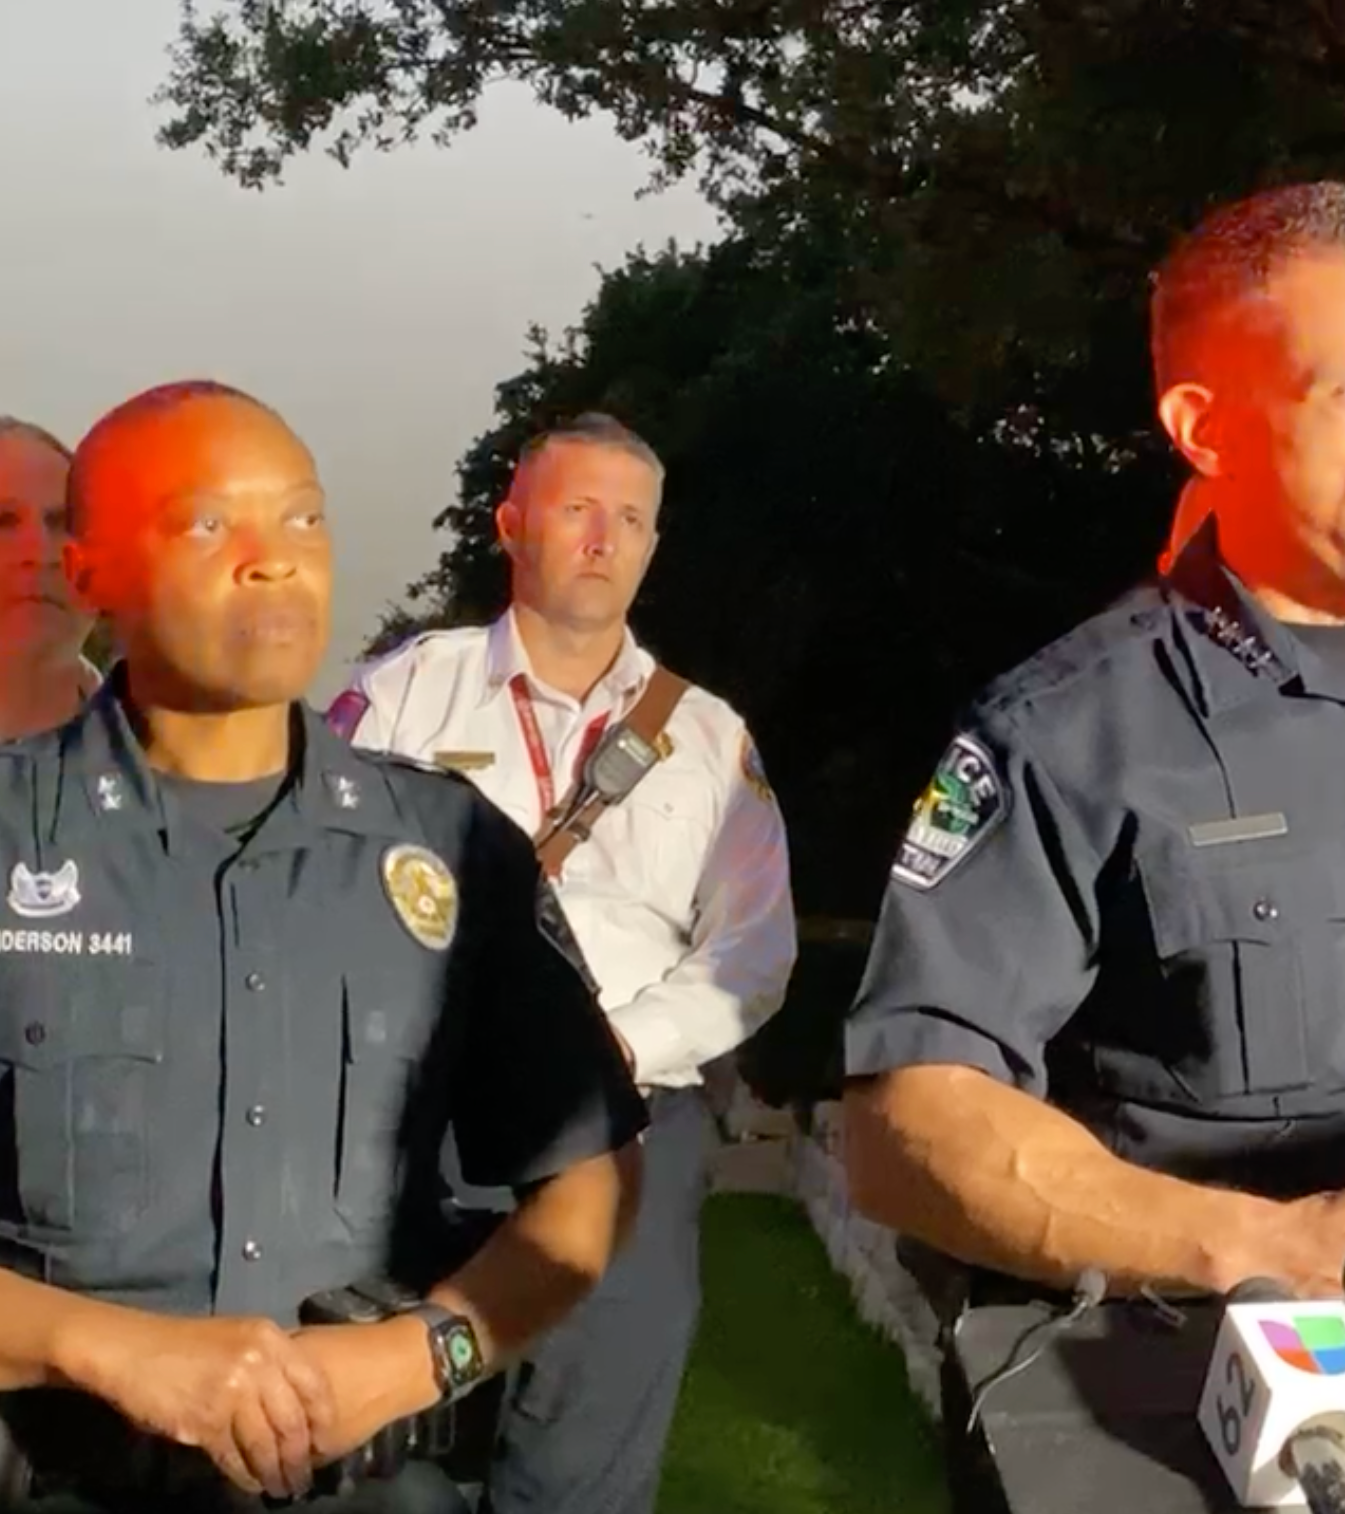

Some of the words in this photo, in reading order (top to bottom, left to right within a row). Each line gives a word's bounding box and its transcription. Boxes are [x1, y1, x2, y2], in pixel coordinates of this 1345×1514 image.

[0, 929, 82, 954] DERSON
[88, 931, 132, 955] 3441
[1215, 1352, 1256, 1457] 62
